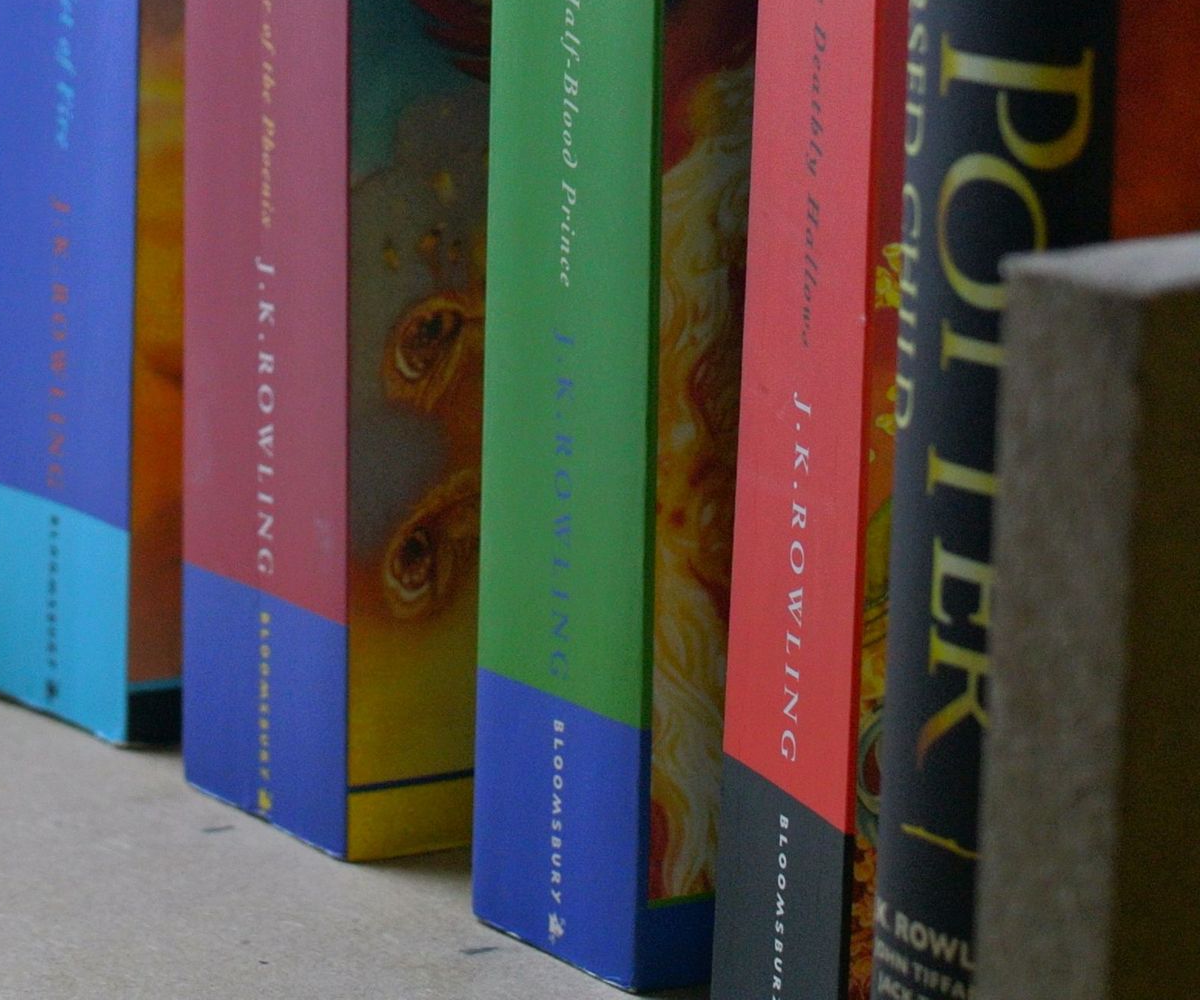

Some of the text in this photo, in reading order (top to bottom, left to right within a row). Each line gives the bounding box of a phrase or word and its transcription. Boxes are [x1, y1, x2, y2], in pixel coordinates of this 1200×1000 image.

[805, 22, 828, 177] Deathly
[559, 180, 577, 288] Prince
[800, 191, 821, 349] Hallows
[550, 718, 565, 904] BLOOMSBURY
[894, 909, 977, 973] ROWL
